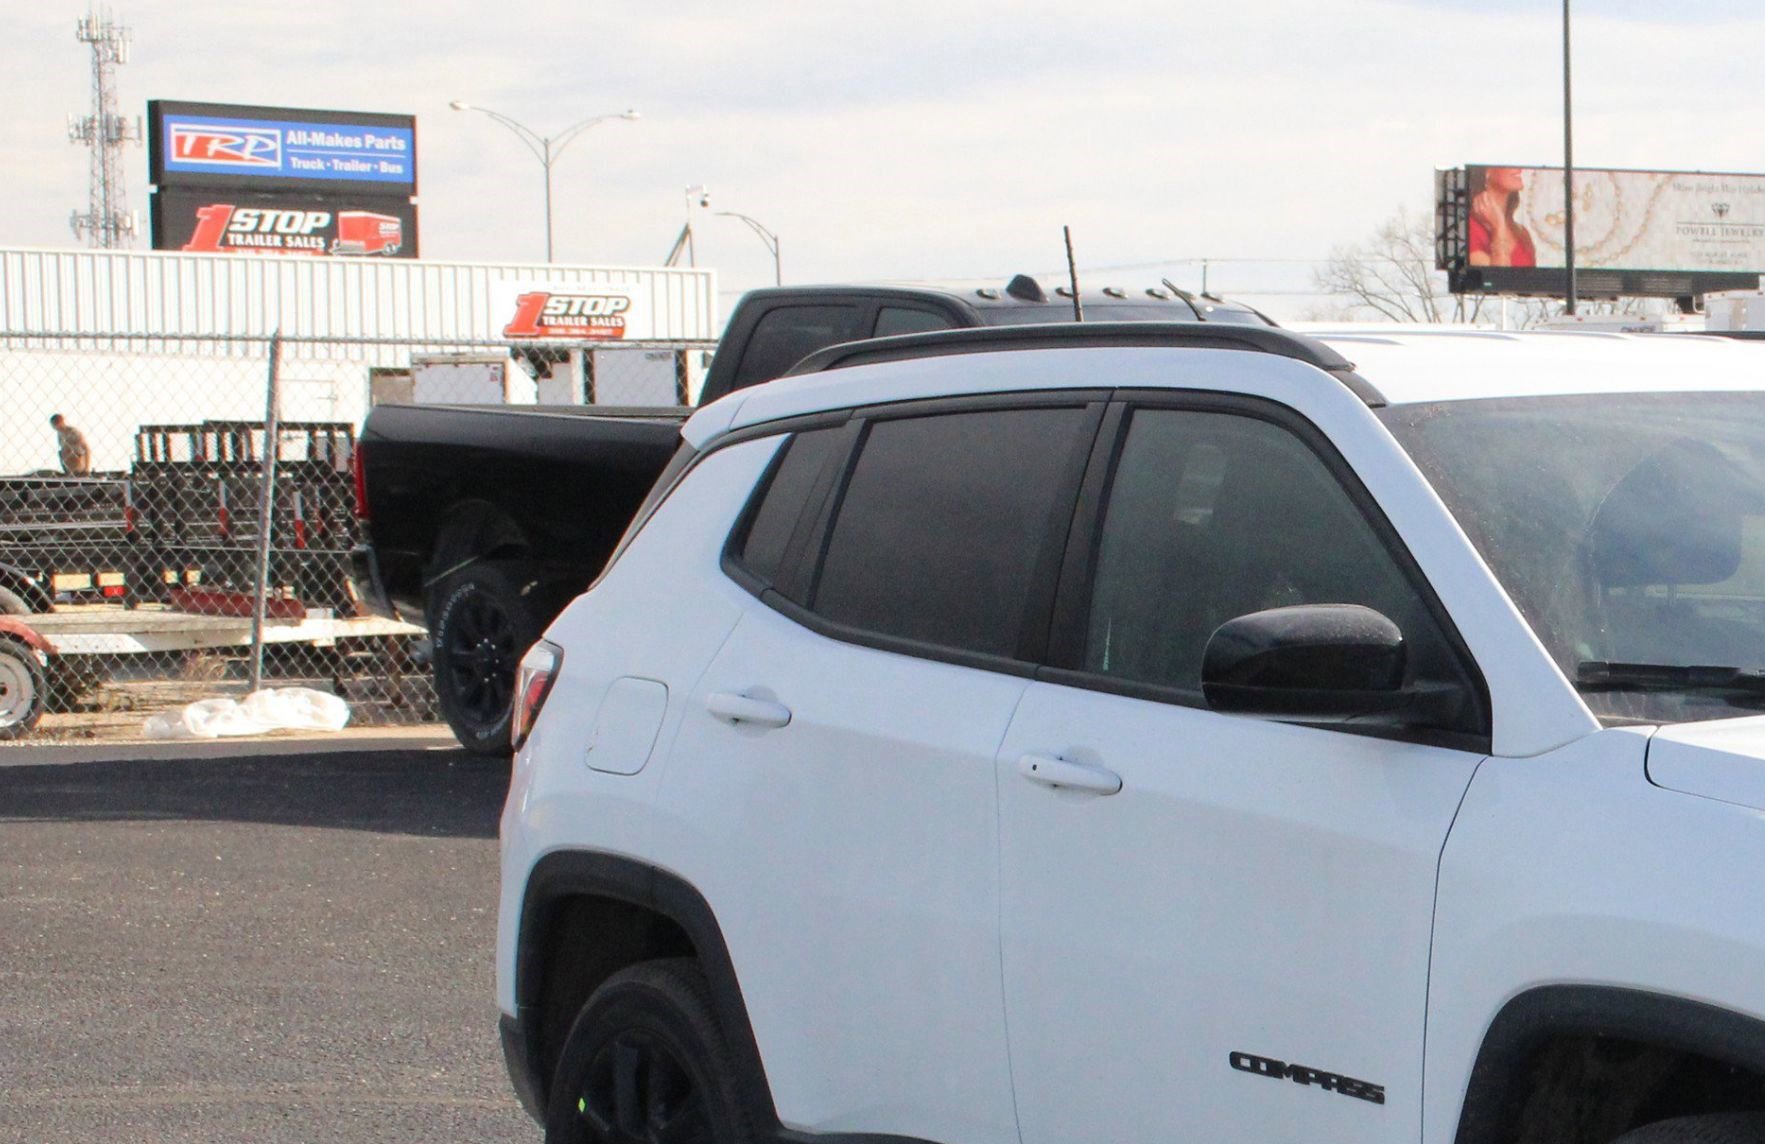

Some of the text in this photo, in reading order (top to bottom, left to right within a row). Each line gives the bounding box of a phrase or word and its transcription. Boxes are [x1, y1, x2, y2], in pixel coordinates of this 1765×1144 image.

[175, 131, 279, 164] TRP
[287, 130, 406, 150] All-Makes Parts
[290, 157, 403, 174] Truck Trailer Bus
[182, 204, 331, 251] 1 STOP
[228, 234, 326, 248] TRAILER SALES
[503, 292, 629, 337] 1 STOP
[542, 316, 624, 327] TRAILER SALES
[1229, 1051, 1385, 1105] COMPASS
